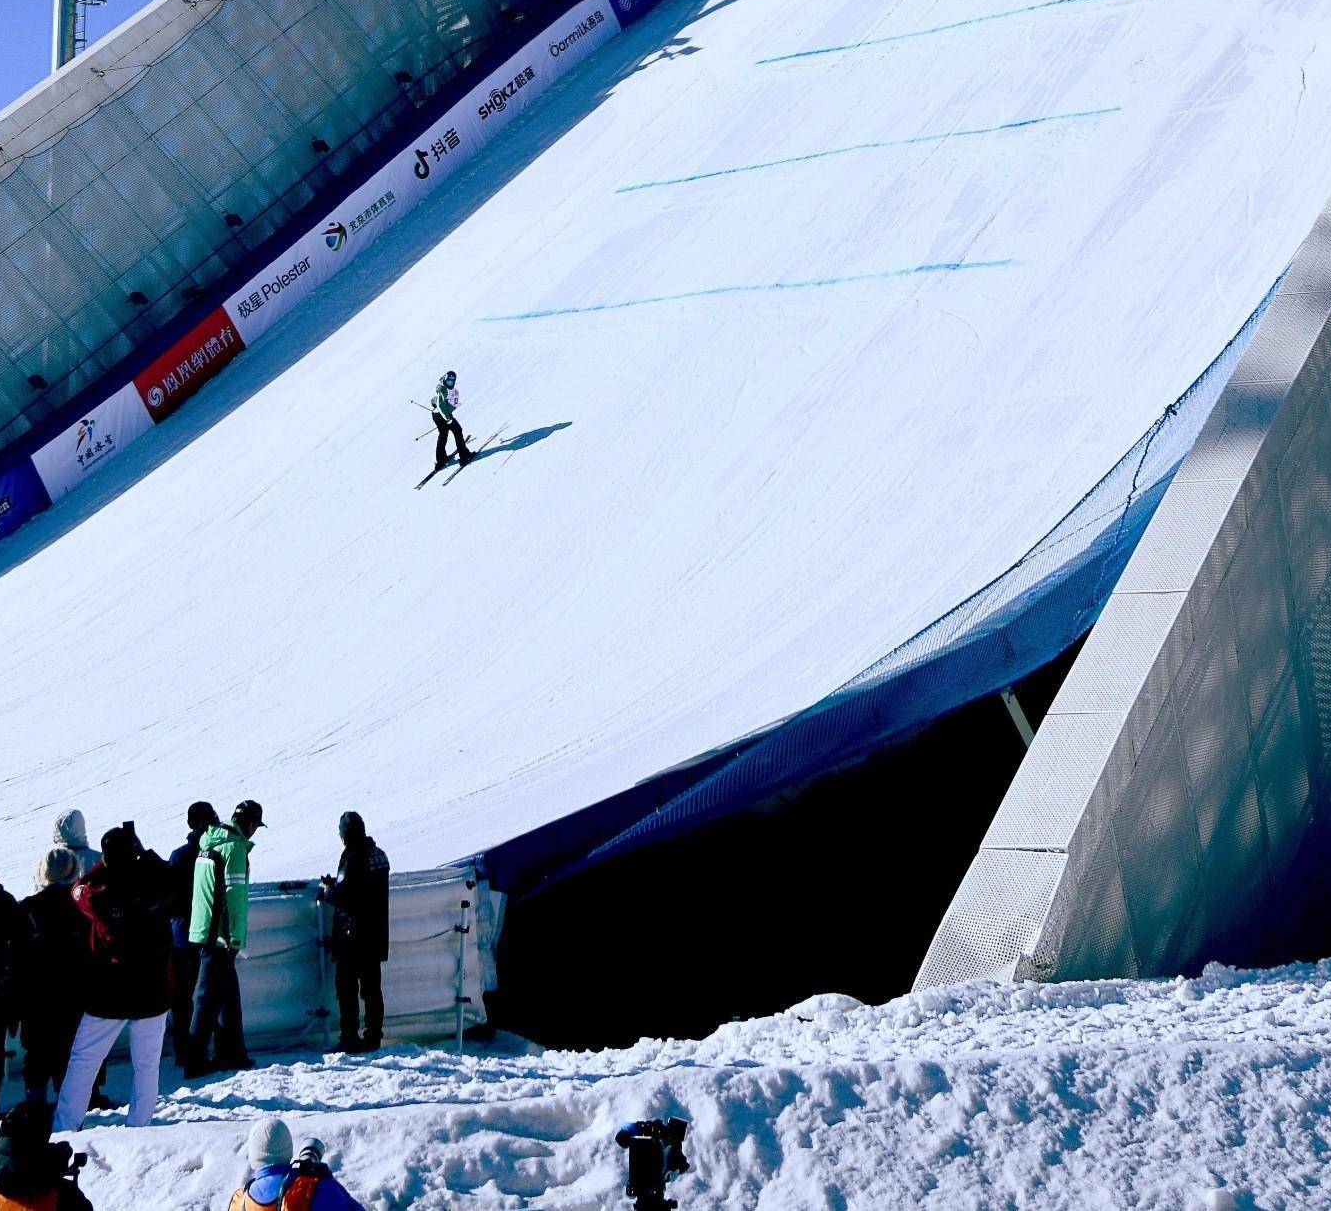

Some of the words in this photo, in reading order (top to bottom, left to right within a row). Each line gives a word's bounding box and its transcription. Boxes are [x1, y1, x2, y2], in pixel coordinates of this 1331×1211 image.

[430, 127, 461, 163] 抖音
[348, 190, 395, 232] 北京市体育局
[237, 291, 265, 319] 极星
[260, 256, 311, 301] Polestar
